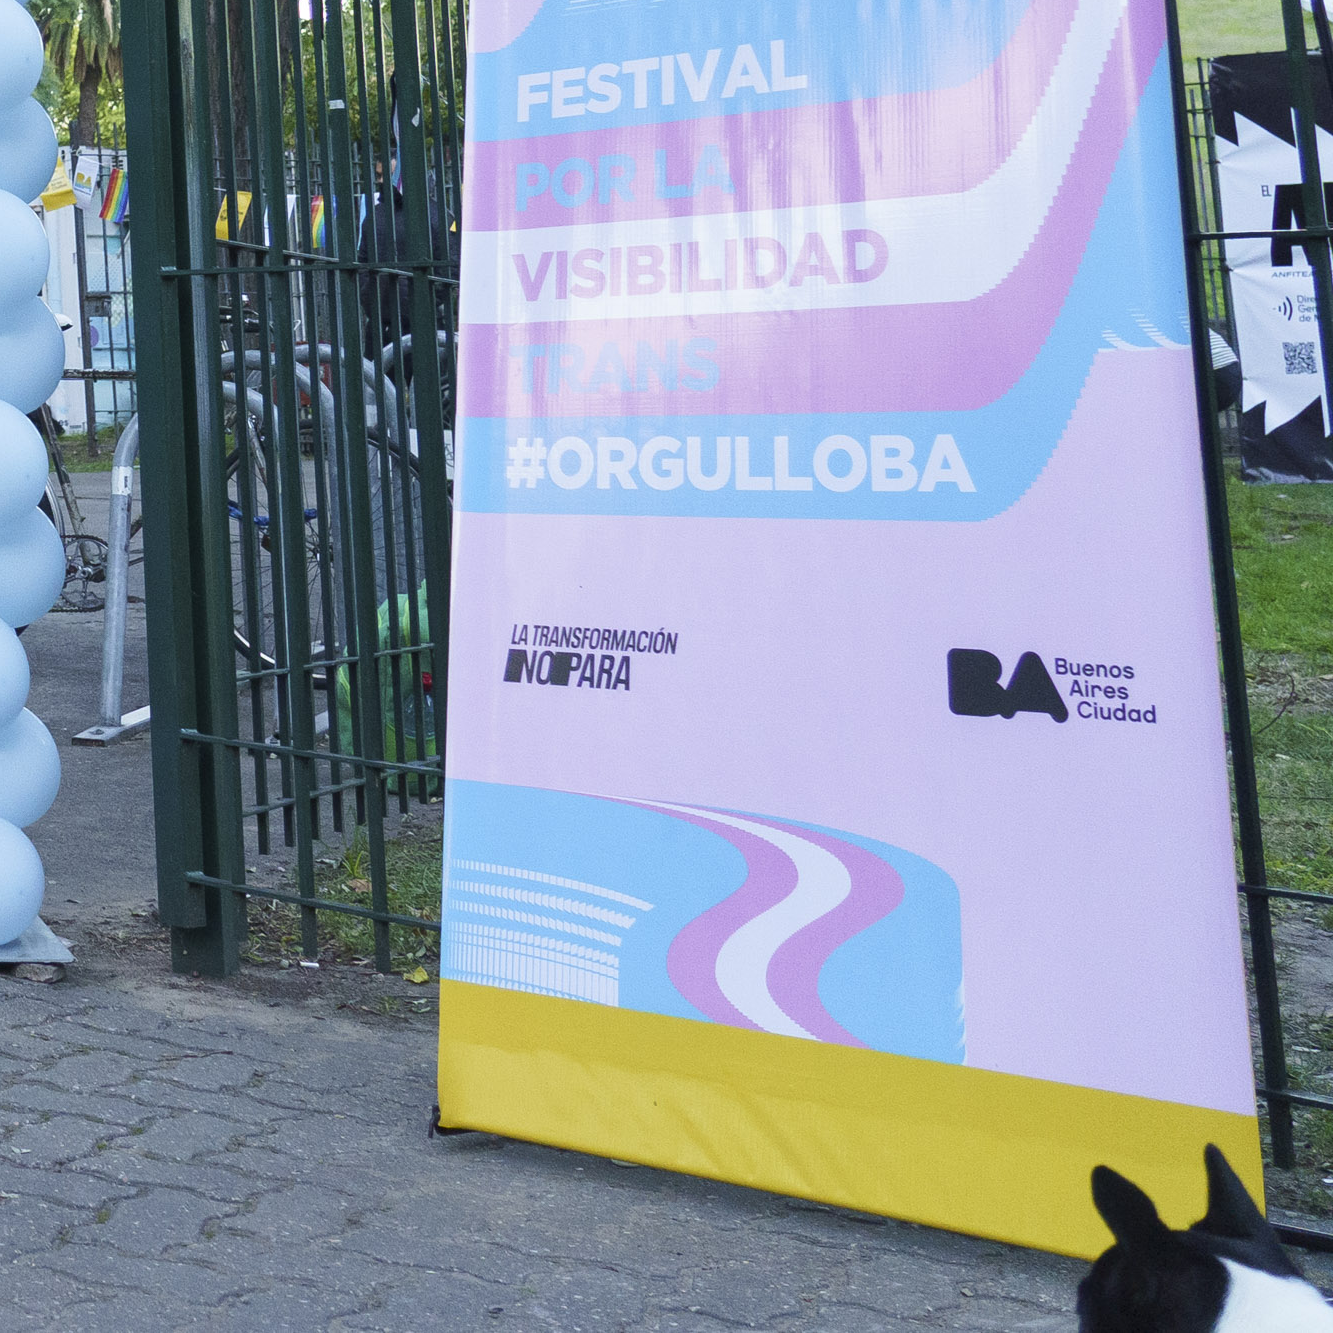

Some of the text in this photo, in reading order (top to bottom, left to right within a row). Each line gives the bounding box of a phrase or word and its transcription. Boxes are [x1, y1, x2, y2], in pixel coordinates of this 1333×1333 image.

[517, 39, 808, 123] FESTIVAL
[515, 144, 736, 212] POR LA
[1261, 185, 1271, 197] EL
[512, 228, 890, 302] VISIBILIDAD
[509, 337, 721, 394] TRANS
[506, 434, 977, 493] #ORGULLOBA
[511, 624, 678, 655] LA TRANSFORMACIÓN
[511, 649, 631, 691] NO PARA
[947, 648, 1069, 723] BA
[1054, 657, 1135, 679] Buenos
[1069, 679, 1129, 700] Aires
[1076, 701, 1157, 724] Ciudad
